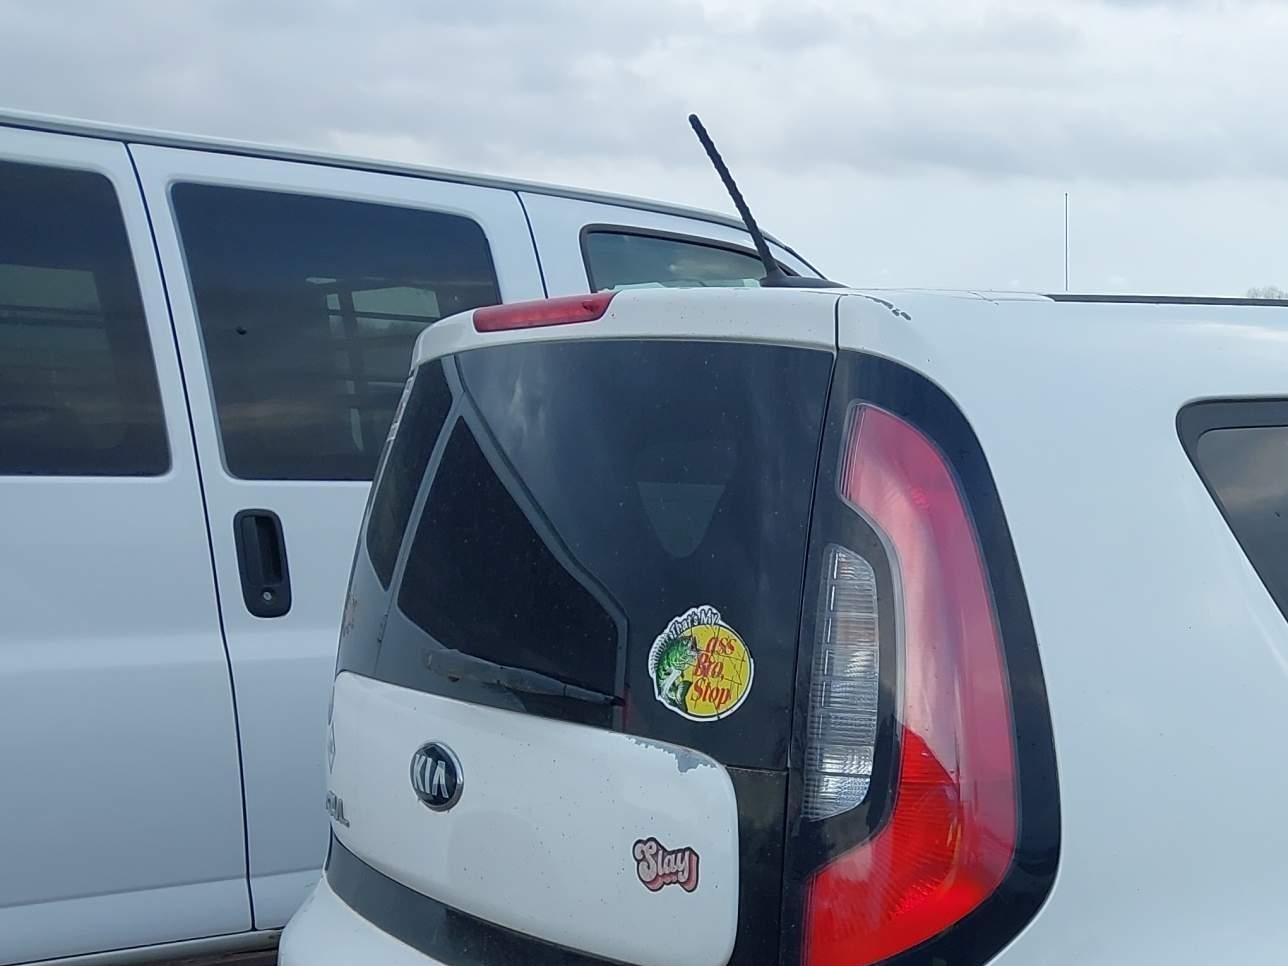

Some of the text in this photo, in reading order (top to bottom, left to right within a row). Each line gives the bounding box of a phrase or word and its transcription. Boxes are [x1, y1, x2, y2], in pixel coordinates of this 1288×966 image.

[693, 678, 732, 710] Stop
[413, 753, 449, 799] KIA
[634, 840, 692, 885] Slay
